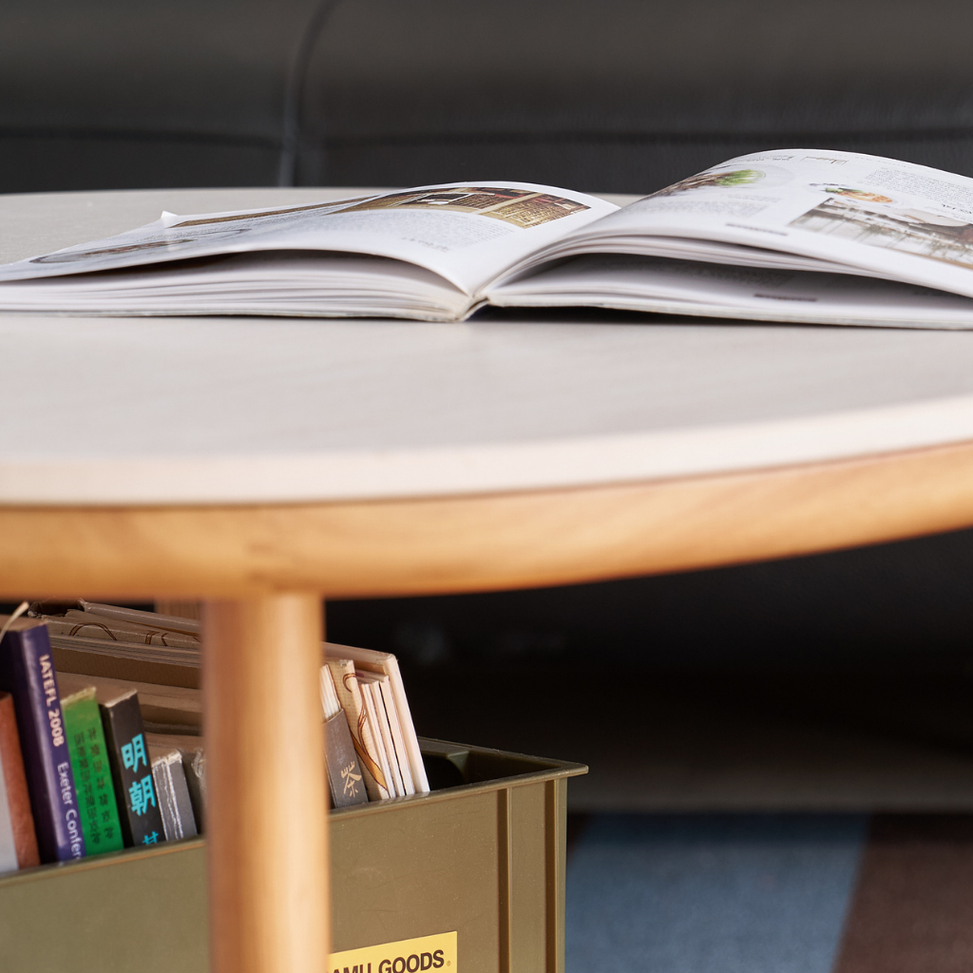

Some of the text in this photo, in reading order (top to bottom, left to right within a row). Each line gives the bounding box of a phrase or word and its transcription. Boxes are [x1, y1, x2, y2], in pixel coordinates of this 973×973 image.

[39, 654, 57, 707] IATEFL
[48, 708, 64, 747] 2008
[57, 762, 74, 805] Exeter
[340, 761, 362, 798] 茶
